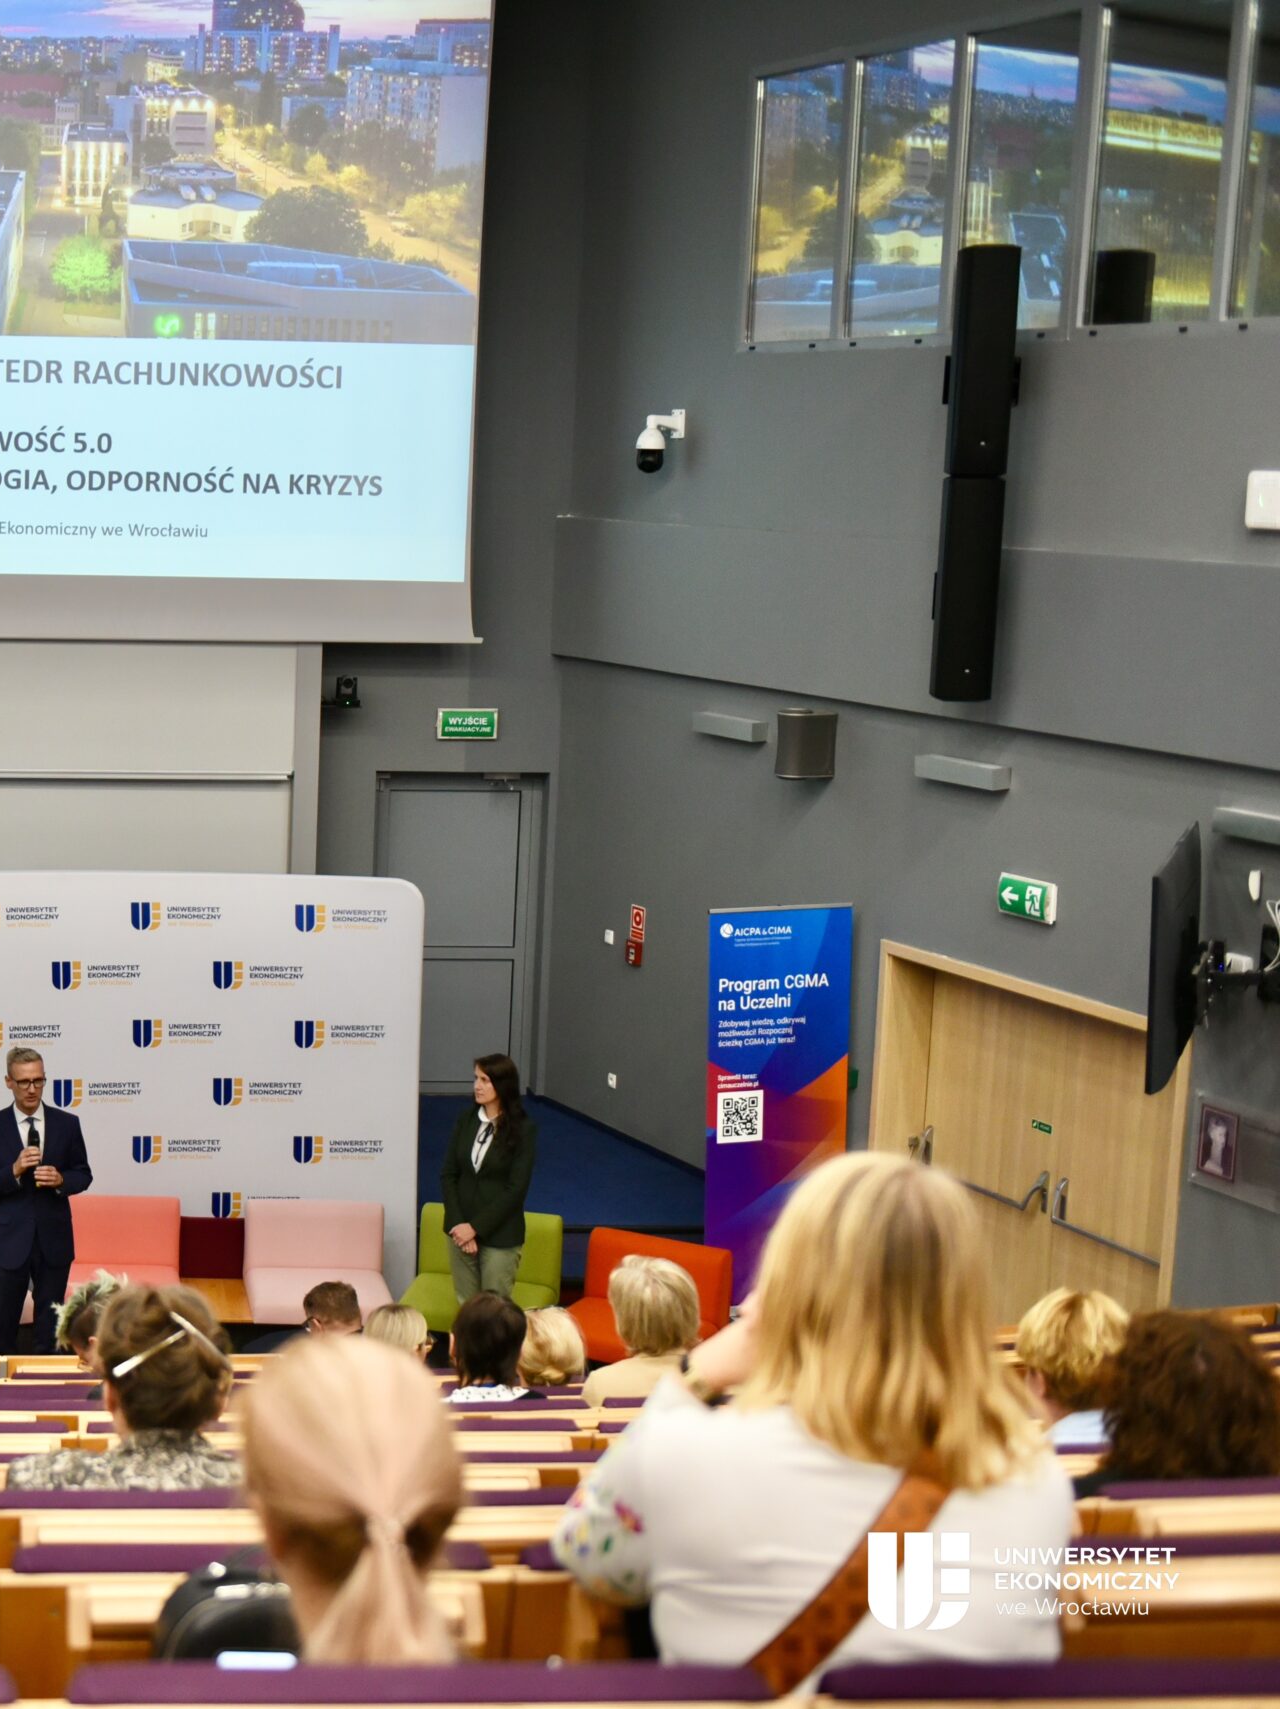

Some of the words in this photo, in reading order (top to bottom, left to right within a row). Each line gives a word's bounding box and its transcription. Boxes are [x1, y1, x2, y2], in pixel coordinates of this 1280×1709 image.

[73, 358, 343, 389] RACHUNKOWOŚCI
[73, 432, 113, 454] 5.0
[66, 466, 235, 494] ODPORNOŚĆ
[242, 472, 281, 495] NA
[288, 474, 383, 497] KRYZYS
[101, 526, 124, 536] we
[128, 523, 208, 538] Wrocławiu
[448, 715, 488, 726] WYJŚCIE
[734, 927, 760, 936] AICPA
[767, 925, 792, 935] CIMA
[718, 978, 780, 995] Program
[784, 973, 829, 989] CGMA
[718, 999, 735, 1011] na
[740, 993, 791, 1010] Uczelni
[9, 1024, 61, 1032] UNIWERSYTET
[718, 1019, 750, 1029] Zdobywaj
[777, 1016, 806, 1025] odkrywaj
[9, 1031, 62, 1039] EKONOMICZNY
[758, 1026, 793, 1036] Rozpocznij
[744, 1038, 765, 1046] CGMA
